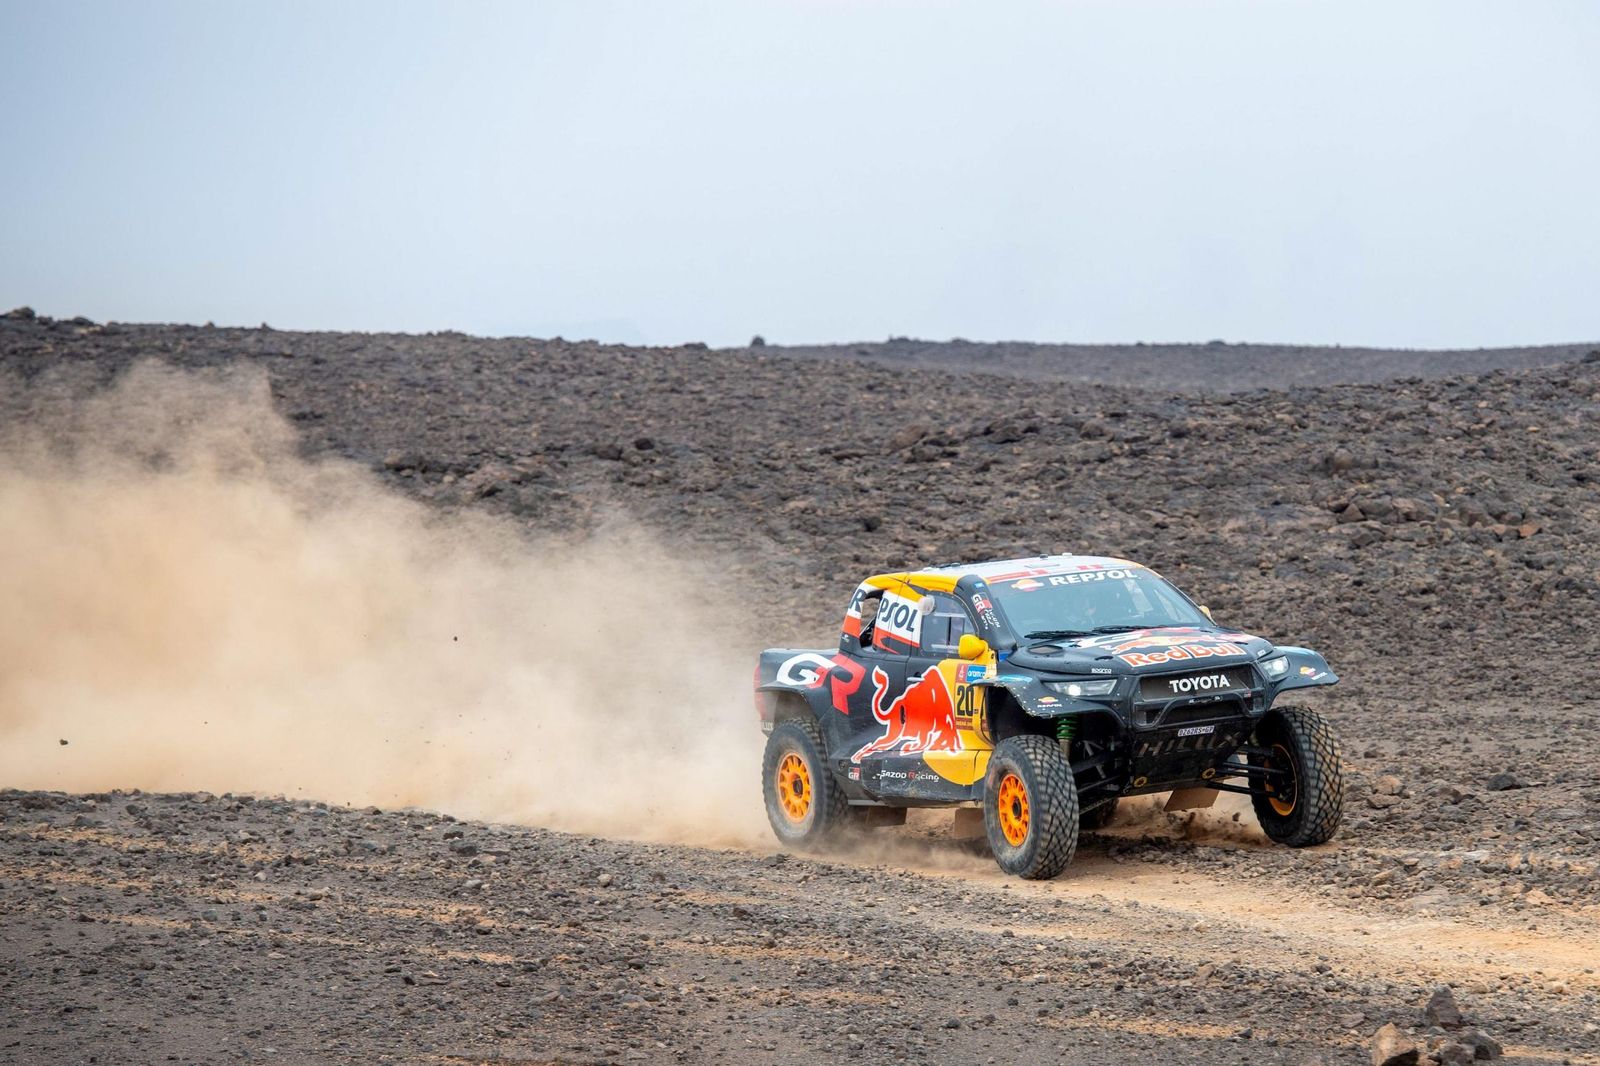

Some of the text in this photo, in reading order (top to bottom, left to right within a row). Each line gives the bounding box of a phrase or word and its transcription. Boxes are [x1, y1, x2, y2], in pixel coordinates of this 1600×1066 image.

[1049, 569, 1140, 586] REPSOL
[849, 588, 918, 632] RPSOL
[1119, 646, 1194, 667] Red
[1181, 643, 1247, 658] Bull
[777, 653, 866, 715] GR
[1169, 674, 1231, 693] TOYOTA
